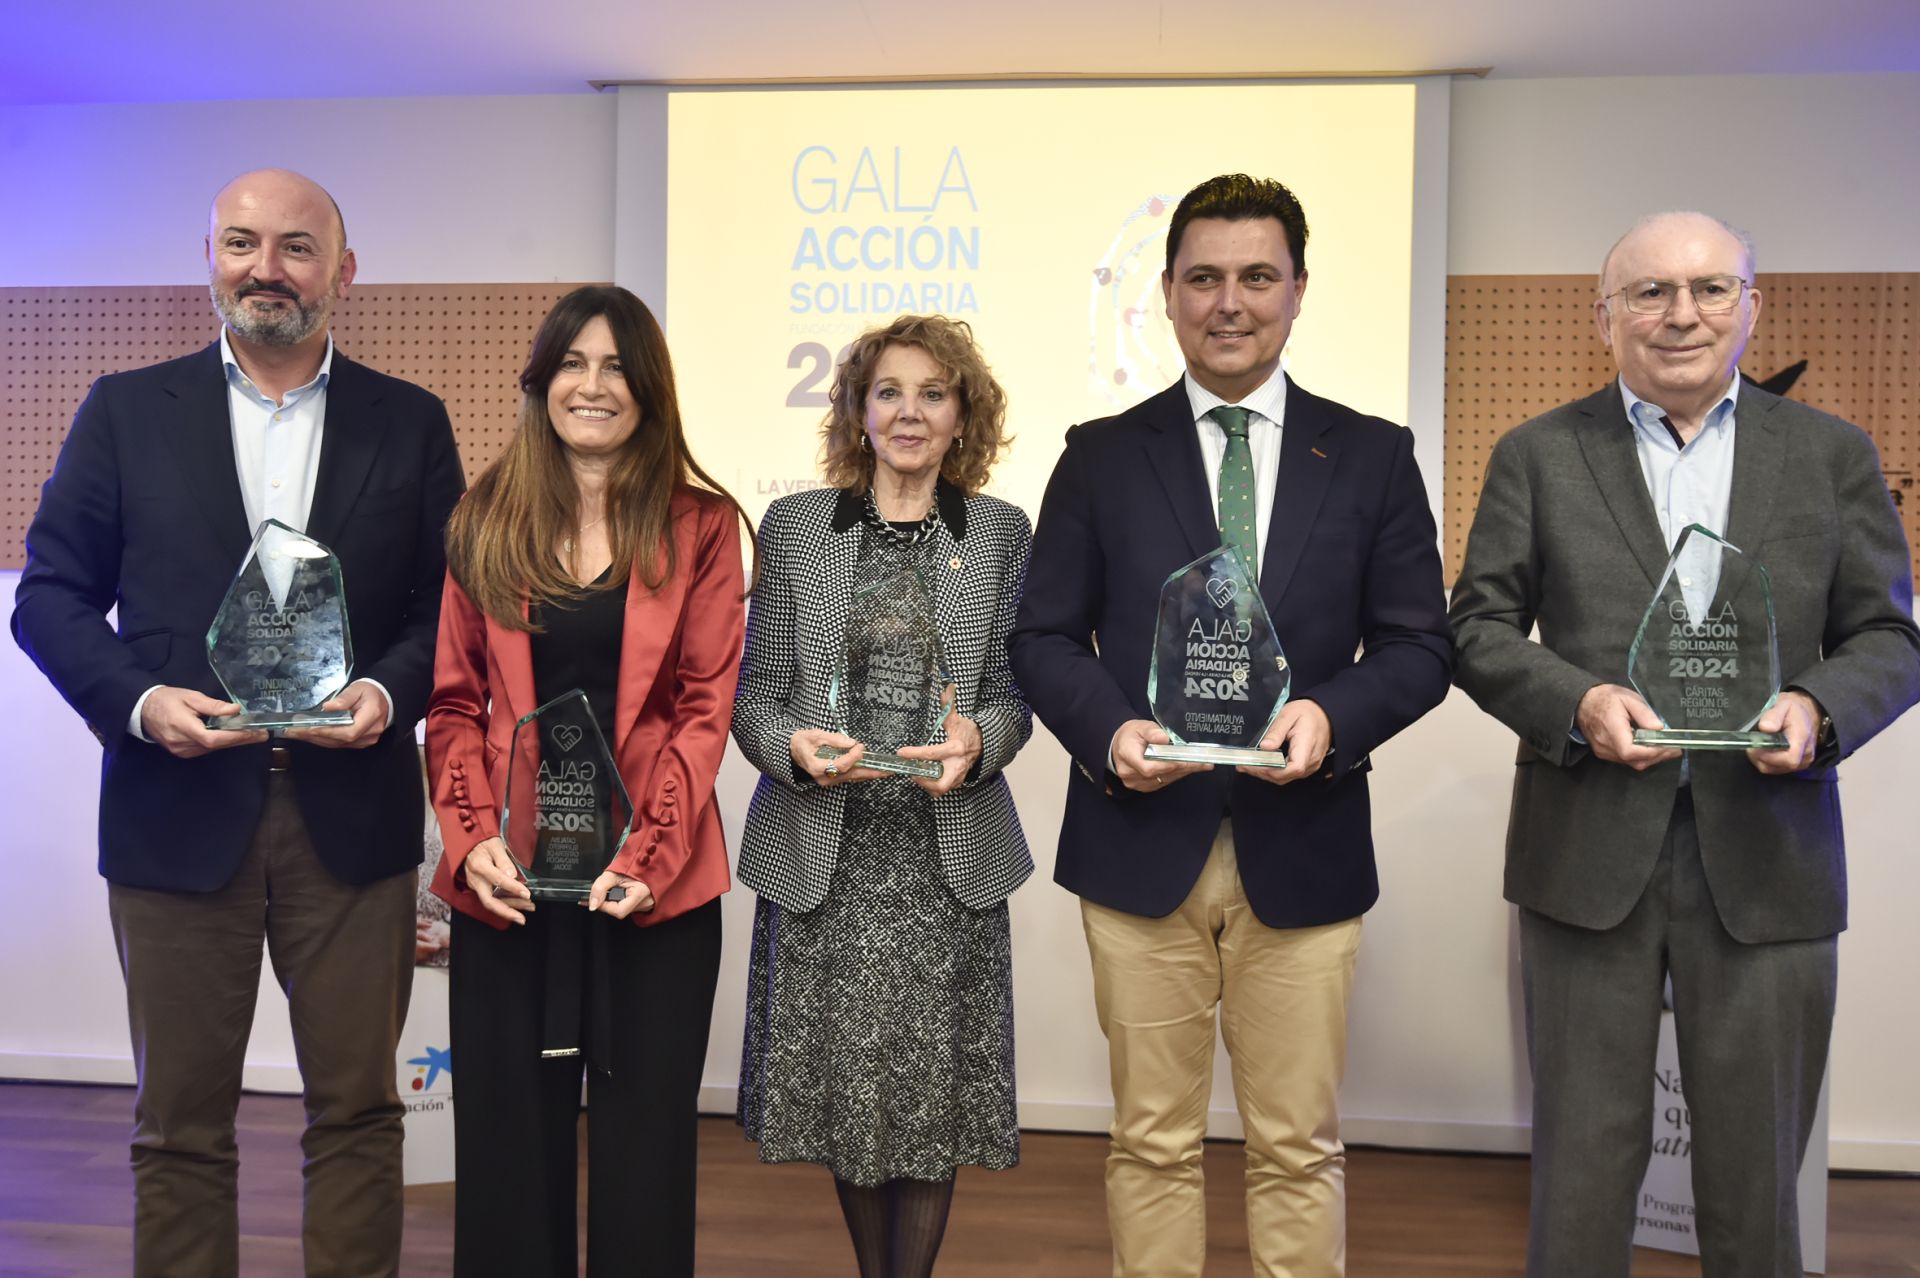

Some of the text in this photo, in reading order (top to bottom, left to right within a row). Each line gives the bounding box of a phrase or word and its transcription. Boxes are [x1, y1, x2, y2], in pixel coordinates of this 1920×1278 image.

[791, 144, 978, 215] GALA
[790, 214, 980, 272] ACCIÓN
[789, 281, 980, 314] SOLIDARIA
[757, 479, 780, 495] LA
[1669, 620, 1738, 638] ACCIÓN
[1669, 640, 1739, 651] SOLIDARIA
[1669, 657, 1740, 679] 2024
[1717, 698, 1729, 708] DE
[1686, 708, 1724, 719] MURCIA
